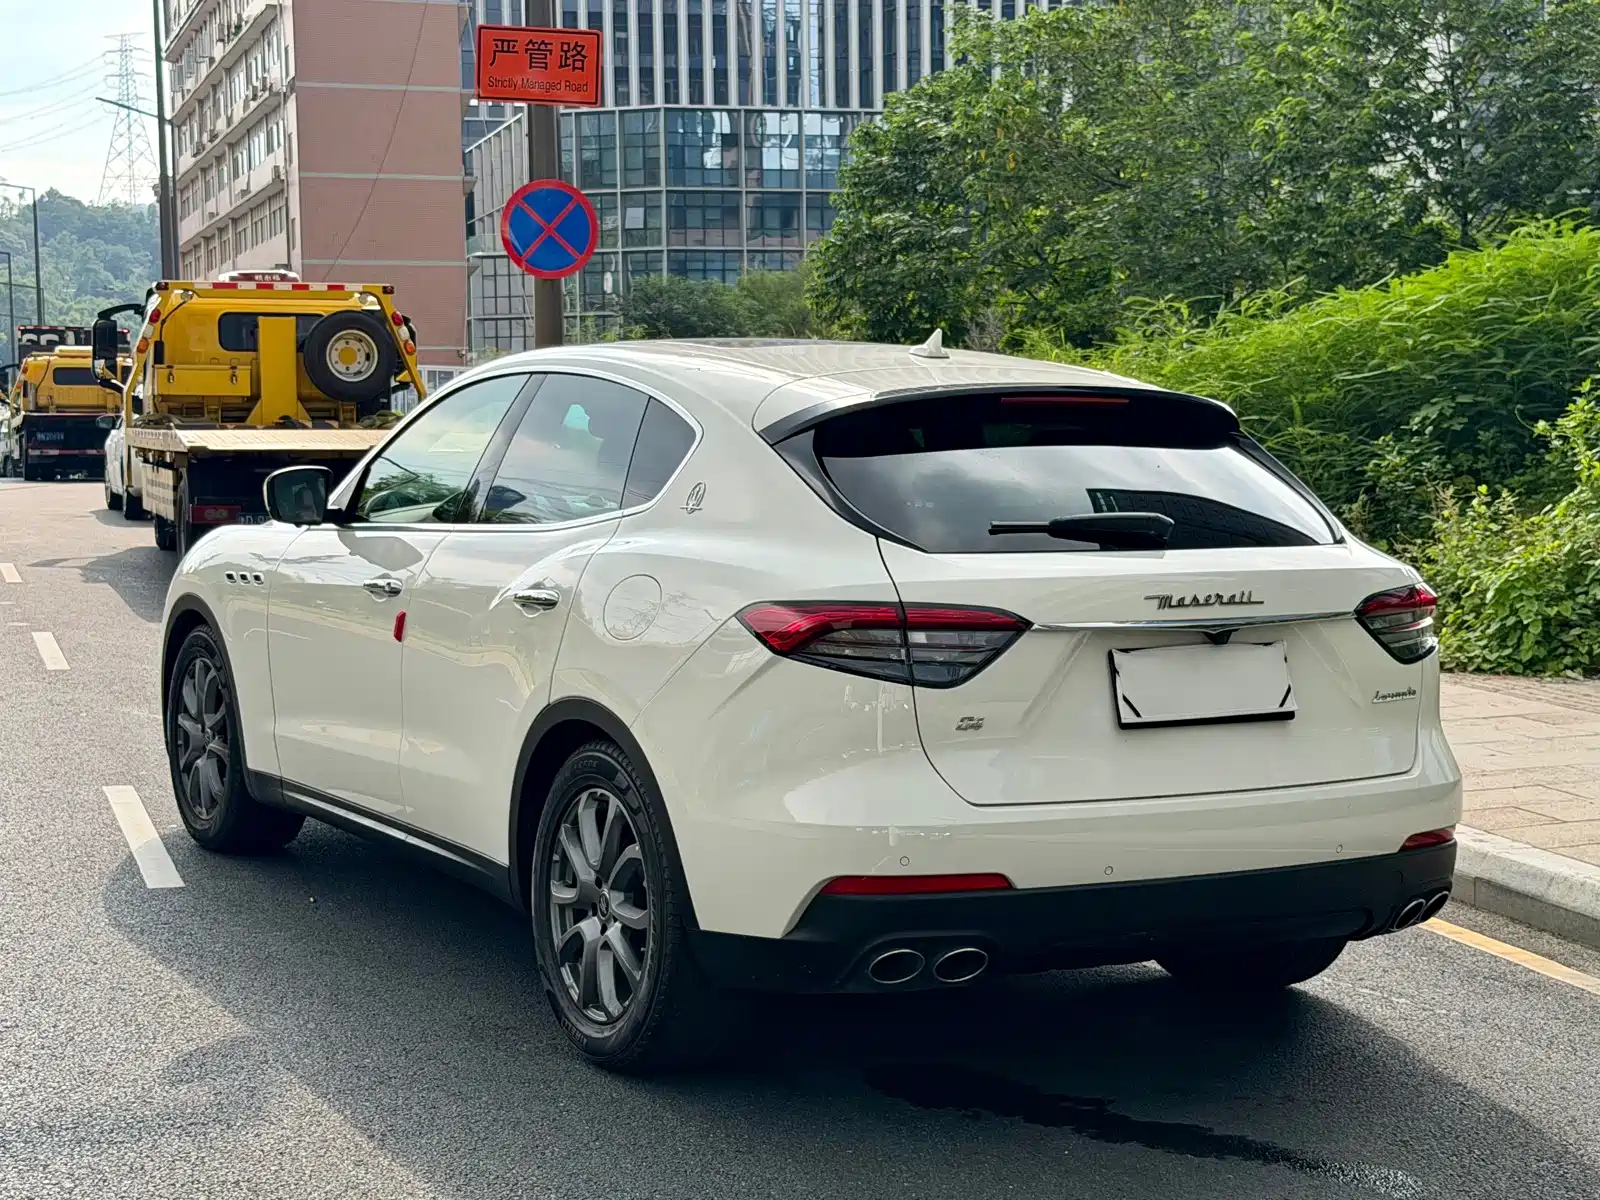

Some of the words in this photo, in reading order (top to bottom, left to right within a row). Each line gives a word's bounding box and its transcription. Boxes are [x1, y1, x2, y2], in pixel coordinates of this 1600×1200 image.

[489, 38, 588, 72] 严管路
[488, 76, 518, 91] Strictly
[521, 78, 561, 93] Managed
[564, 80, 588, 93] Road
